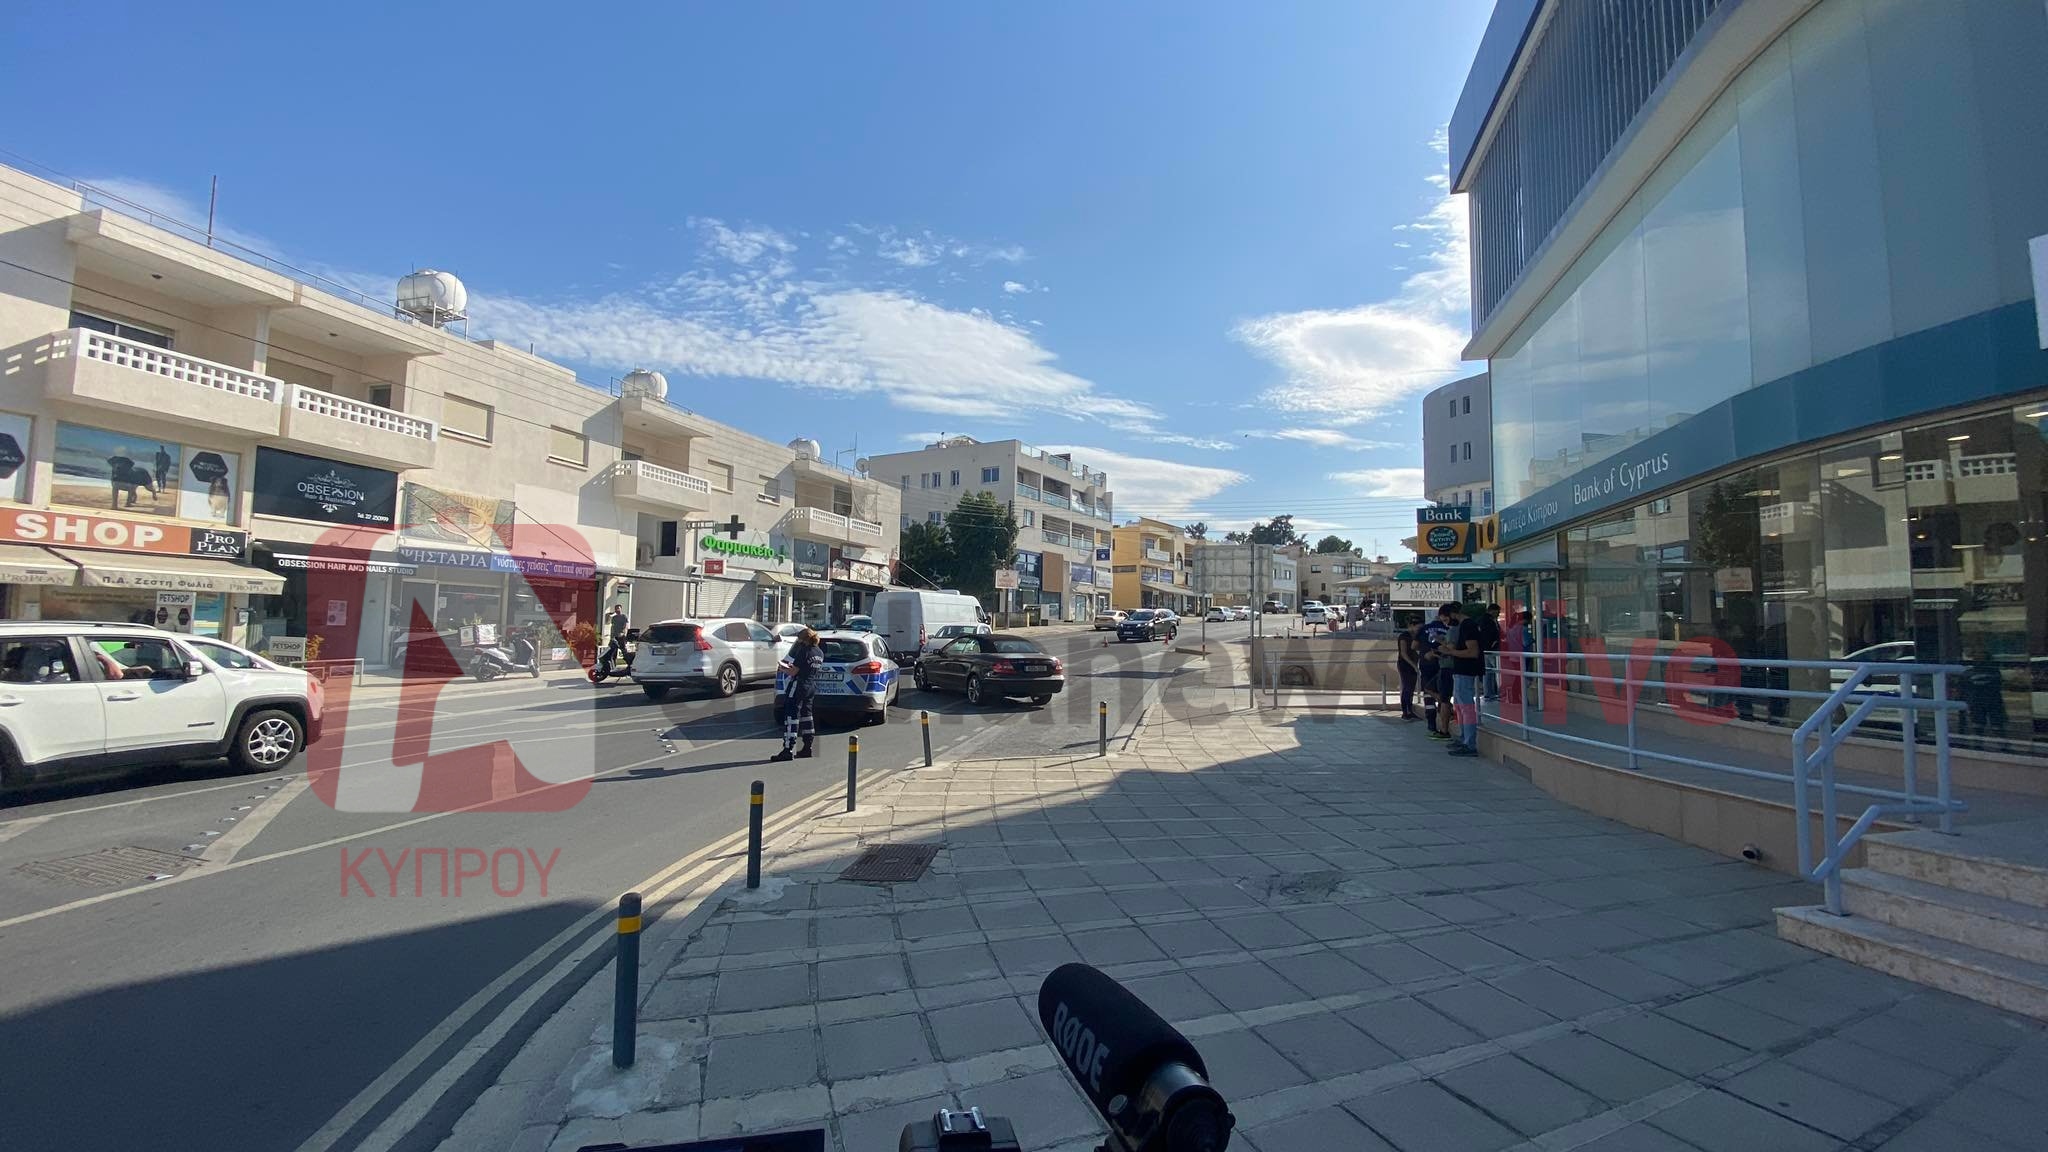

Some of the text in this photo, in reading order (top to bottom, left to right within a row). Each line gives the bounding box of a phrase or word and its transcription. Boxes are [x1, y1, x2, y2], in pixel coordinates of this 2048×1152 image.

[1573, 452, 1669, 505] Bank of Cyprus
[297, 481, 365, 501] OBSESSION
[1425, 509, 1463, 521] Bank
[1527, 500, 1558, 526] Κύπρου
[14, 512, 165, 548] SHOP
[204, 532, 235, 545] PRO
[196, 541, 240, 554] PLAN
[704, 535, 775, 558] Φαρμακείο
[278, 559, 414, 575] OBSESSION HAIR AND NAILS STUDIO
[1053, 1001, 1111, 1093] RØDE
